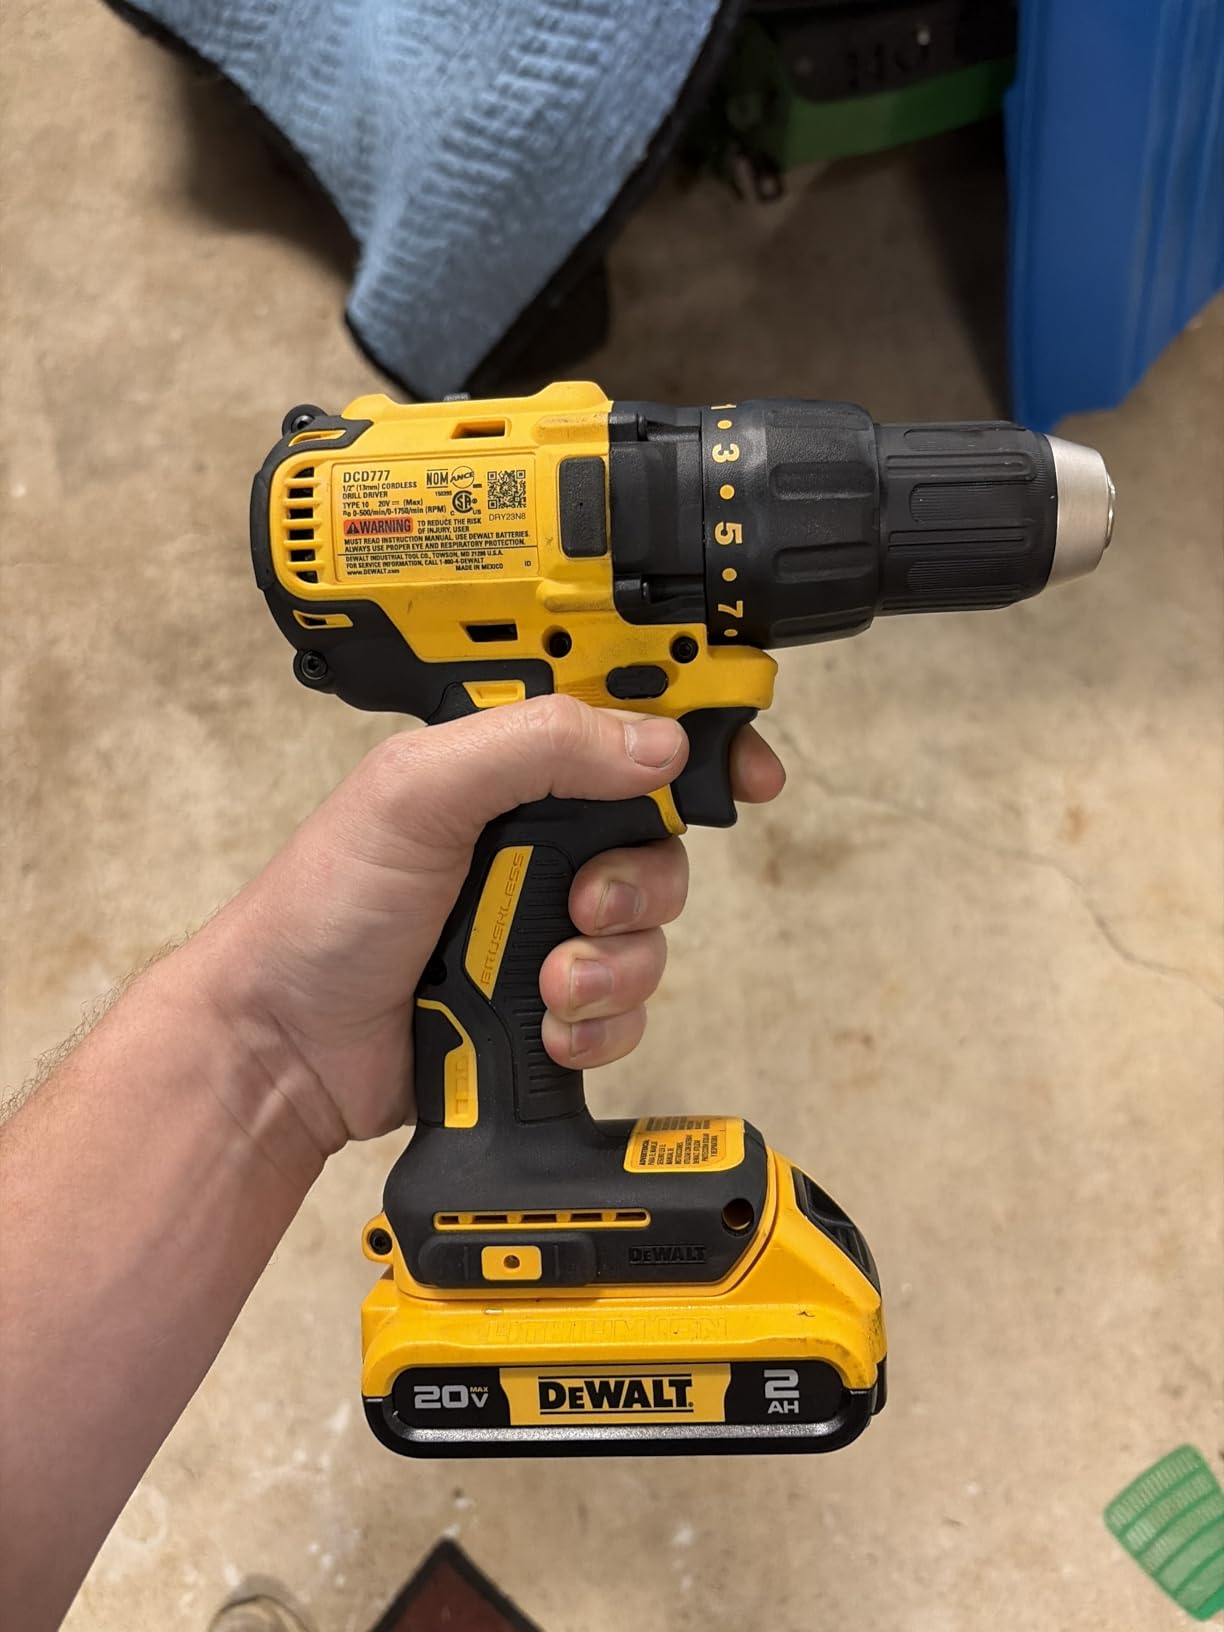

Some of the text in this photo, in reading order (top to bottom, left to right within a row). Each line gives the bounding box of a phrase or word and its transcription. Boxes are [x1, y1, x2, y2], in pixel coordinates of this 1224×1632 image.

[712, 443, 740, 463] 3
[343, 470, 390, 483] DCD777
[426, 472, 448, 485] NOM
[356, 484, 380, 492] (13mm)
[403, 498, 423, 506] (Max)
[425, 505, 446, 514] (RPM)
[427, 518, 452, 526] REDUCE
[489, 513, 526, 521] DRY23N8
[360, 519, 411, 533] WARNING
[714, 522, 742, 545] 5
[717, 600, 743, 618] 7
[764, 1369, 799, 1398] 2
[768, 1400, 799, 1414] AH
